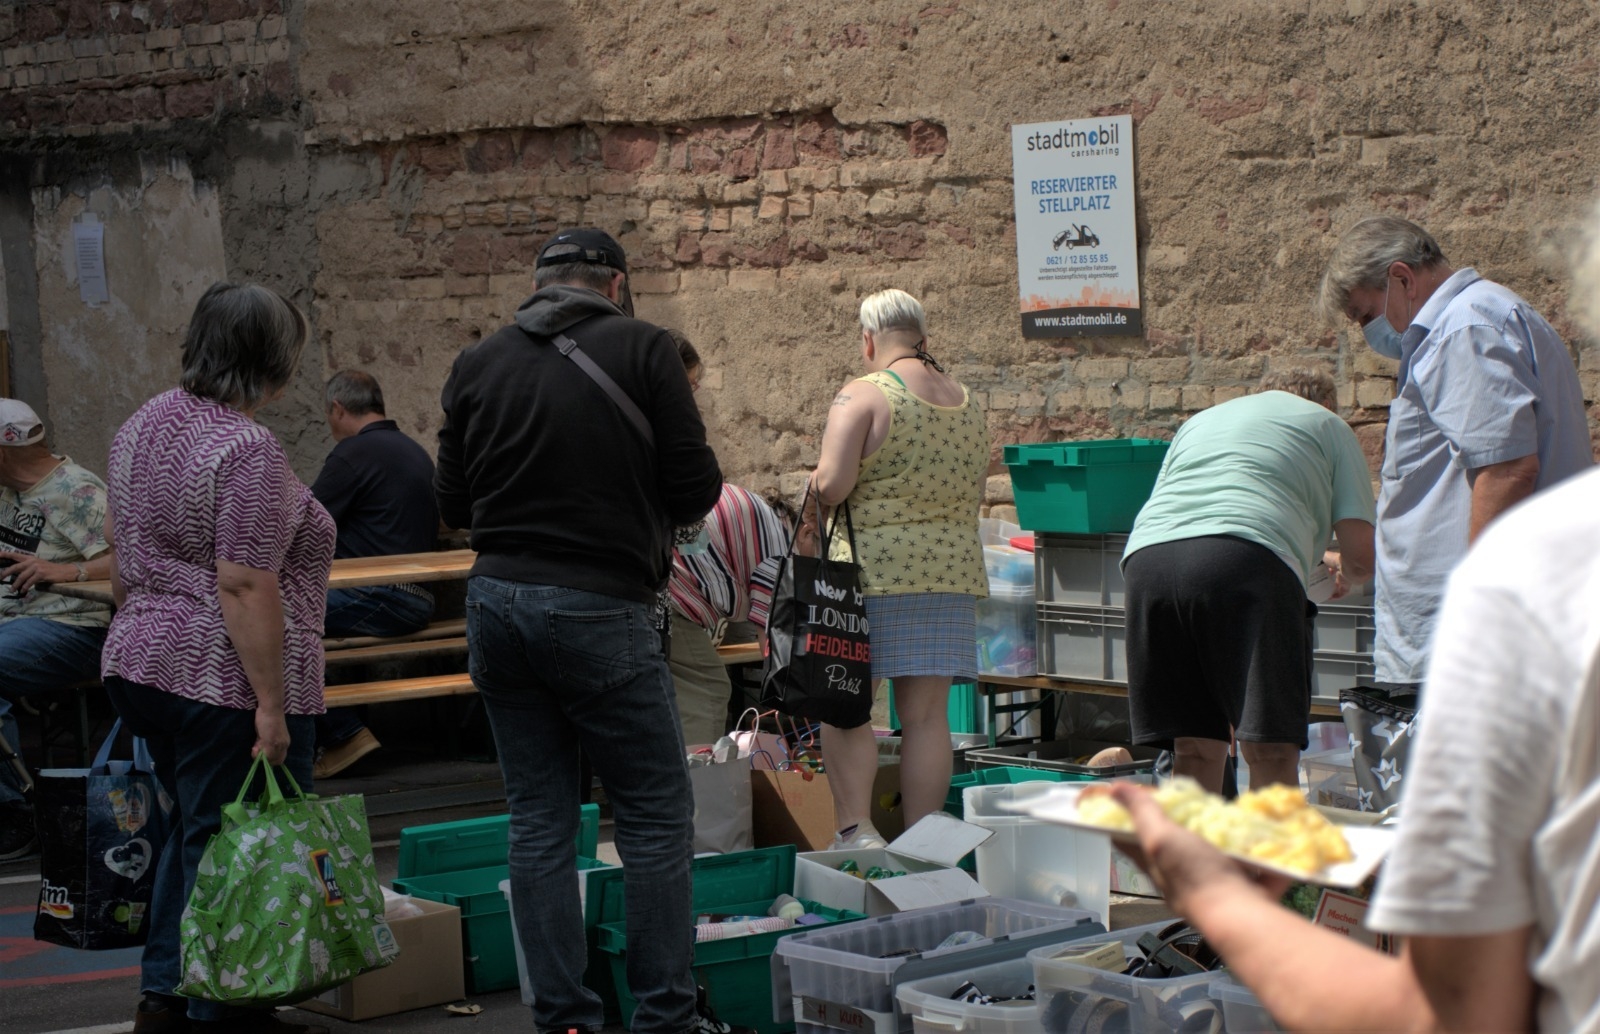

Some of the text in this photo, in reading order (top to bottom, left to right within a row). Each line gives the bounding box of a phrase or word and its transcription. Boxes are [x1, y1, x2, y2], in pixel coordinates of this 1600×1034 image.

[1027, 123, 1119, 151] stadtmobil
[1071, 147, 1119, 157] carsharing
[1031, 175, 1117, 195] RESERVIERTER
[1039, 195, 1111, 213] STELLPLATZ
[1046, 256, 1062, 265] 0621
[1069, 255, 1078, 264] 12
[1079, 254, 1088, 264] 85
[1089, 254, 1098, 263] 55
[1099, 253, 1109, 263] 85
[1035, 312, 1127, 327] www.stadtmobil.de
[814, 579, 847, 602] New
[807, 604, 869, 636] LONDO
[825, 664, 862, 695] Paris
[1327, 909, 1358, 925] Machen
[818, 1004, 826, 1021] H
